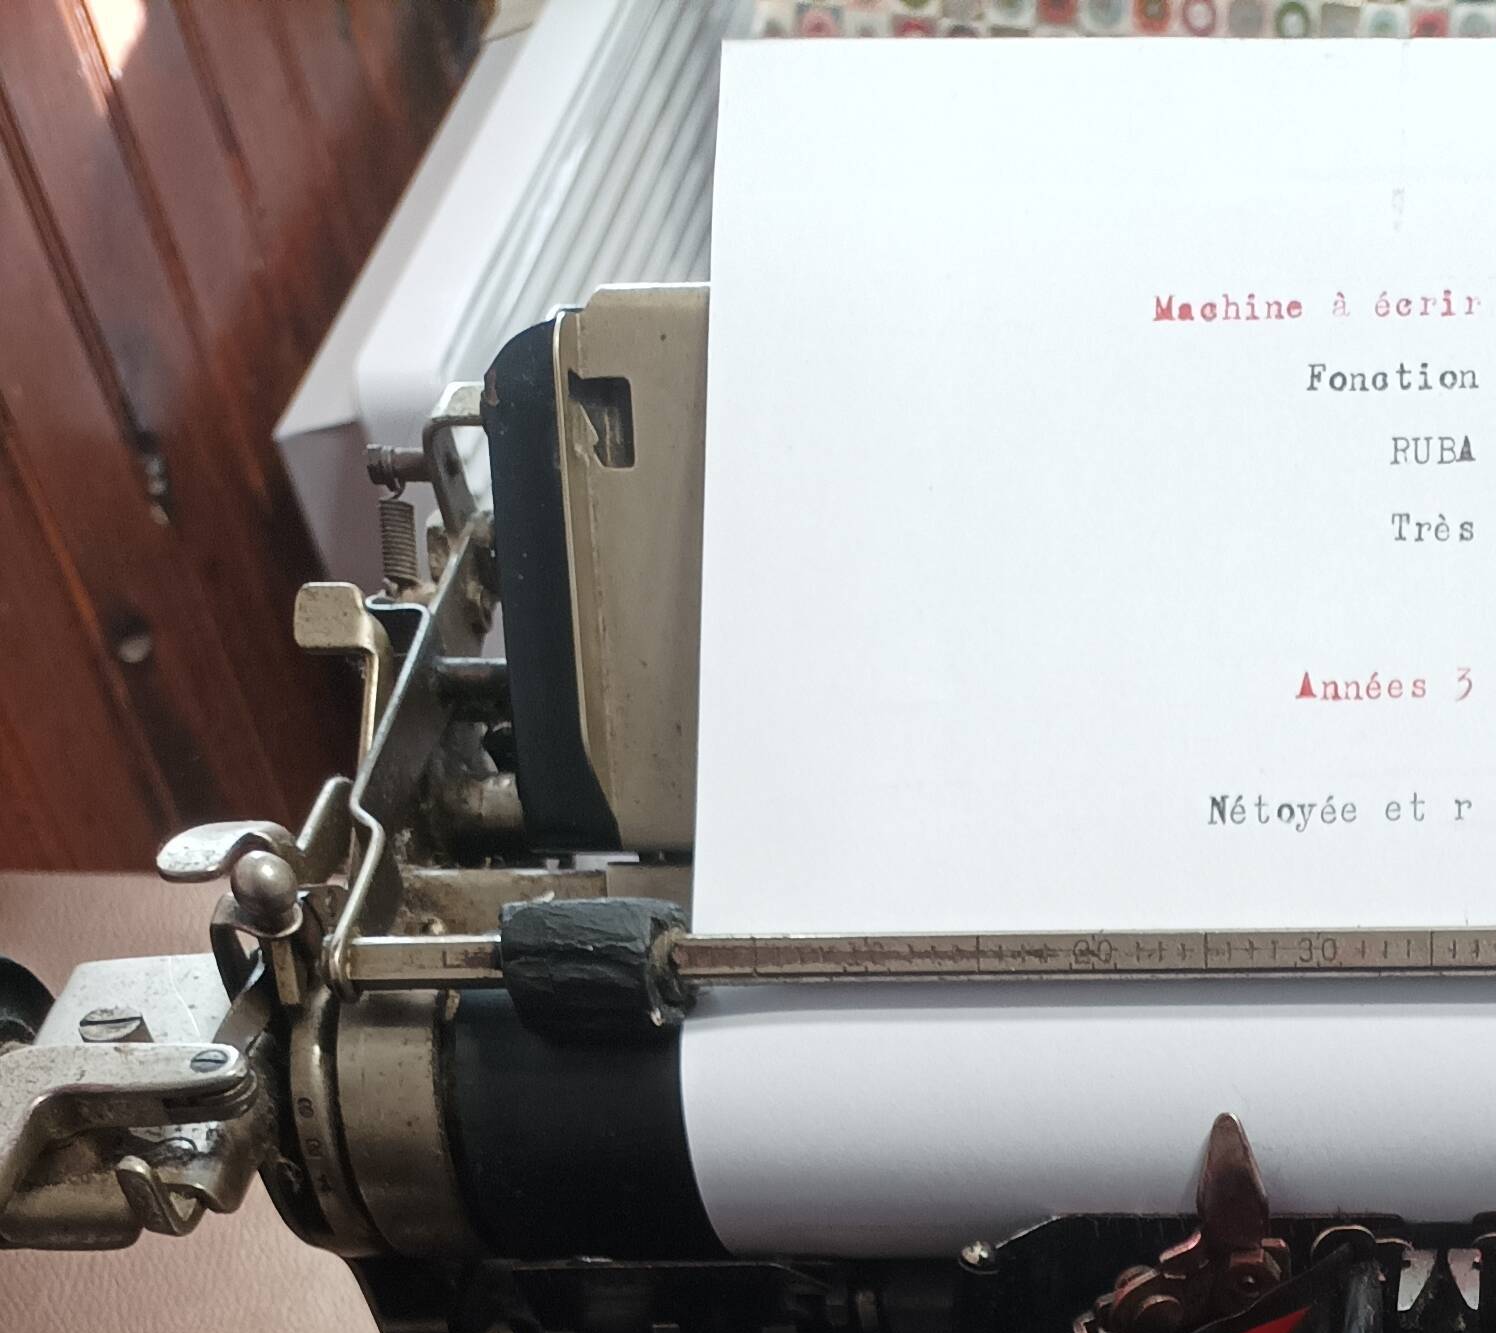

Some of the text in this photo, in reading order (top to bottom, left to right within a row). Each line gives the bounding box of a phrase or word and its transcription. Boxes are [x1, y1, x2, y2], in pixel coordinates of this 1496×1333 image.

[1153, 293, 1302, 322] Machine
[1331, 291, 1351, 318] à
[1306, 362, 1479, 392] Fonction
[1390, 435, 1476, 465] RUBA
[1392, 513, 1474, 542] Très
[1296, 672, 1426, 701] Années
[1458, 669, 1472, 700] 3
[1208, 795, 1356, 832] Nétoyée
[1385, 792, 1425, 821] et
[1455, 799, 1472, 820] r
[1298, 937, 1338, 963] 30
